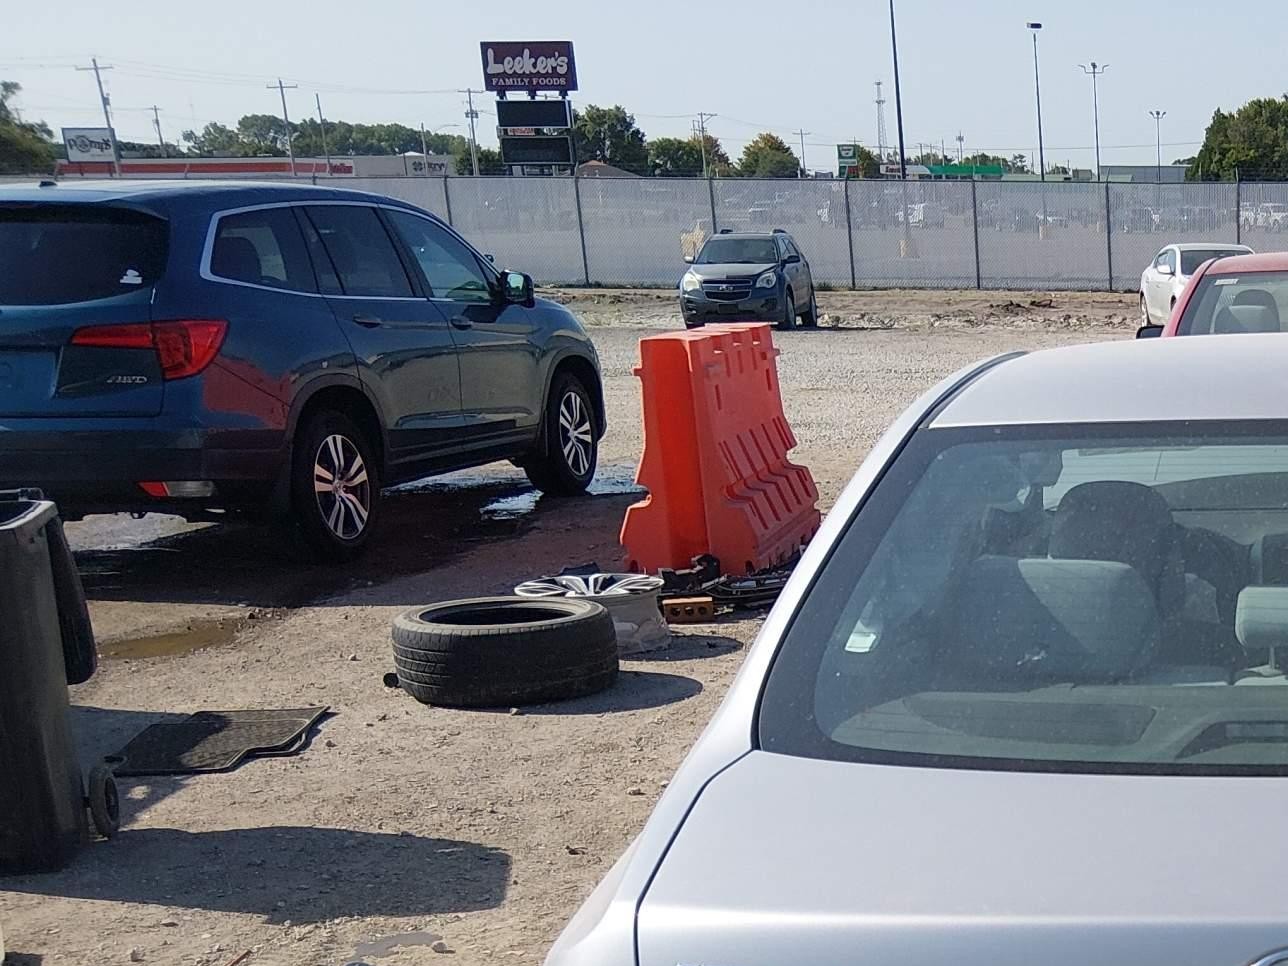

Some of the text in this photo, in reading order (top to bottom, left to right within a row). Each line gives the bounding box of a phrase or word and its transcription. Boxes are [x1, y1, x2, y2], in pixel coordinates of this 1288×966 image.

[487, 48, 568, 74] Leeker's
[492, 78, 567, 86] FAMILY FOODS
